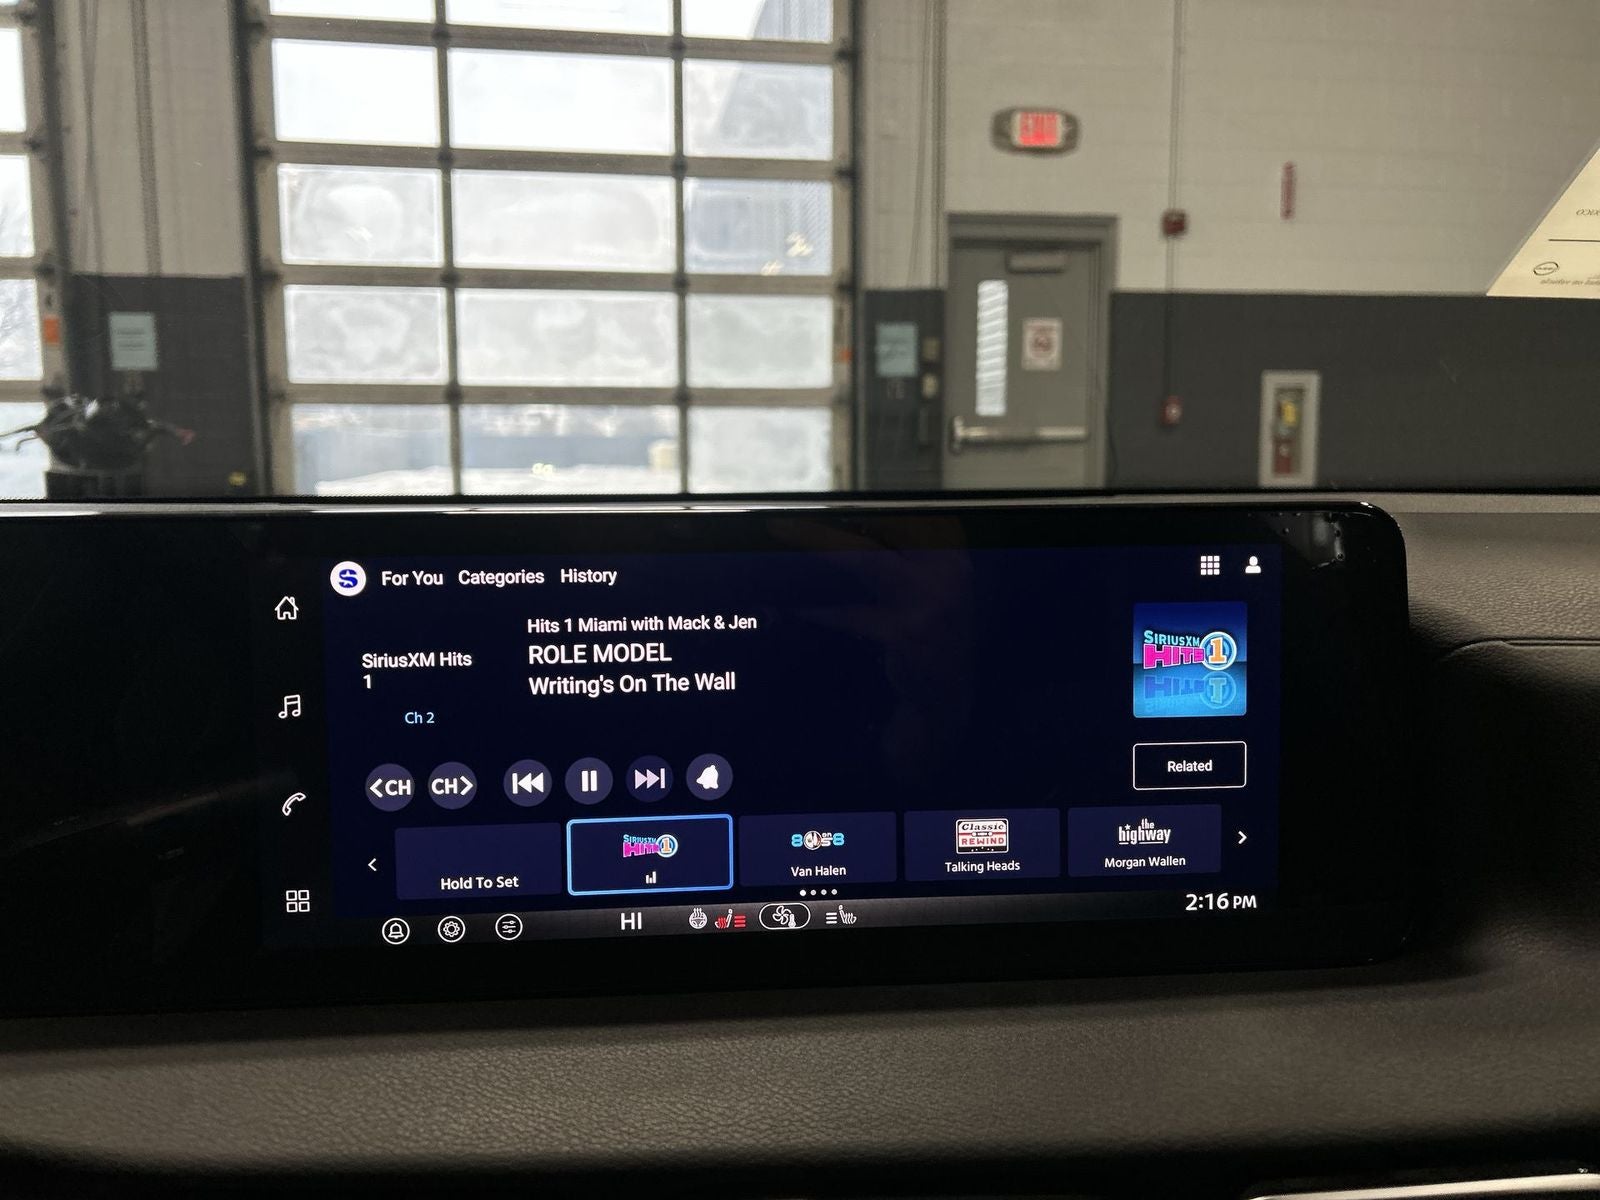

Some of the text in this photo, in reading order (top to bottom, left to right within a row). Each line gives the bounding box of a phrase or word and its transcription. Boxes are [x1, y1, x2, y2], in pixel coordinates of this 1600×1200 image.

[381, 570, 444, 587] For You
[458, 568, 545, 588] Categories
[560, 568, 618, 586] History
[527, 614, 758, 634] Hits 1 Miami with Mack & Jen
[528, 642, 673, 665] ROLE MODEL
[1208, 637, 1227, 664] 1
[361, 651, 473, 669] SiriusXM Hits
[362, 674, 372, 689] 1
[528, 671, 736, 698] Writing's On The Wall
[404, 711, 435, 725] Ch 2
[1167, 759, 1213, 773] Related
[961, 823, 1005, 831] Classic
[1141, 818, 1155, 829] the
[961, 837, 1005, 846] REWIND
[1118, 824, 1171, 845] highway
[790, 864, 847, 877] Van Halen
[944, 859, 1021, 874] Talking Heads
[1104, 855, 1186, 870] Morgan Wallen
[440, 875, 520, 891] Hold To Set
[1185, 892, 1257, 911] 2:16 PM
[620, 911, 642, 931] HI
